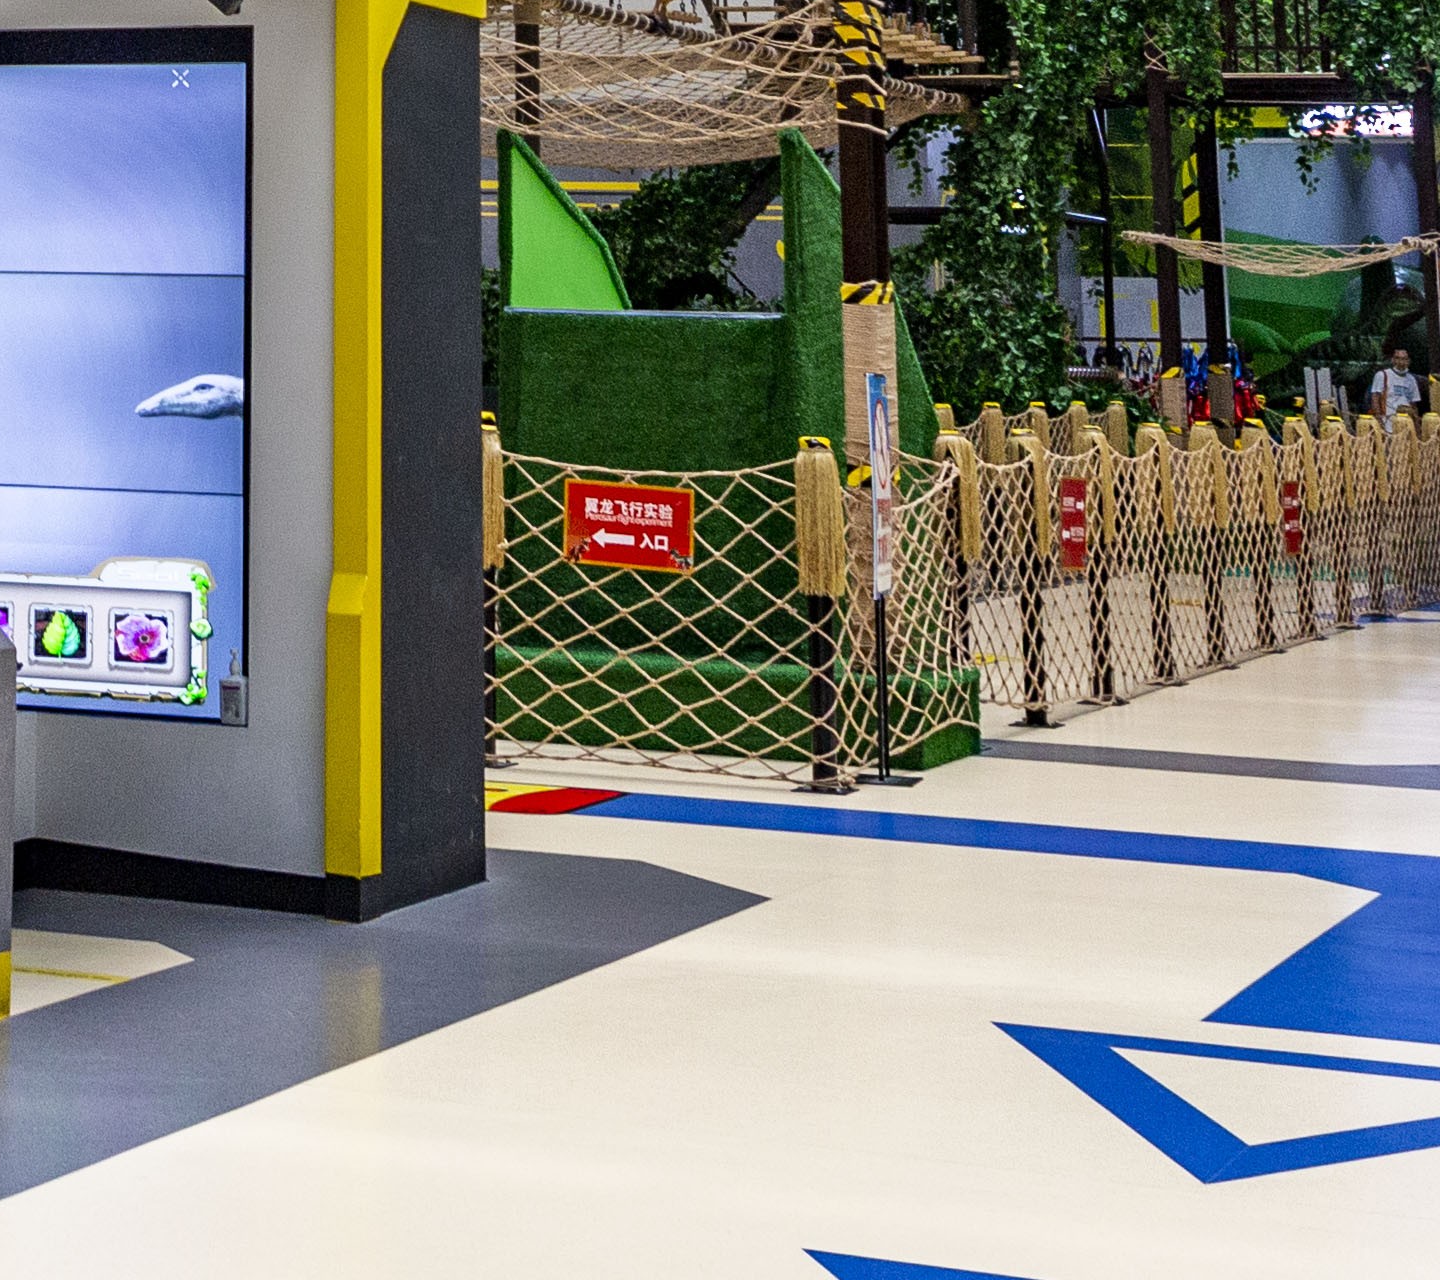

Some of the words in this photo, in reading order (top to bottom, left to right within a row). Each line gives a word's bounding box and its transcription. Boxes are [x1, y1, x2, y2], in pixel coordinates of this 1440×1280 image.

[584, 496, 674, 521] 翼龙飞行实验
[639, 532, 670, 552] 入口
